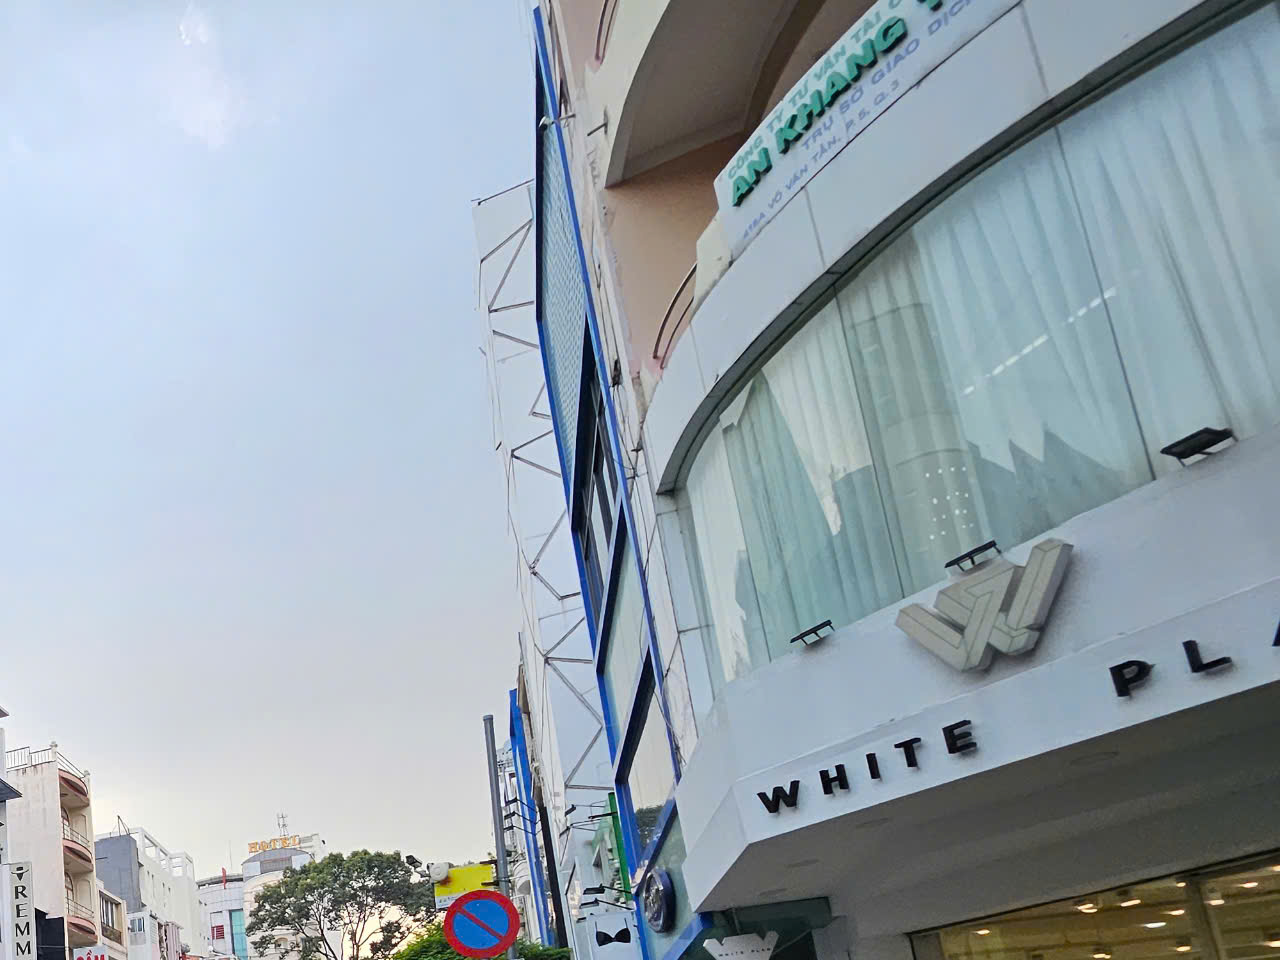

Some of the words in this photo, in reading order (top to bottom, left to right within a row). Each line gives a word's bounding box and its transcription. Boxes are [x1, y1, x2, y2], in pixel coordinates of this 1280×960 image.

[871, 37, 921, 87] GIAO
[728, 134, 763, 180] CÔNG
[765, 108, 786, 134] TY
[731, 146, 774, 207] AN
[774, 15, 909, 155] KHANG
[757, 718, 979, 815] WHITE
[1109, 615, 1280, 698] PL
[247, 834, 301, 854] HOTEL
